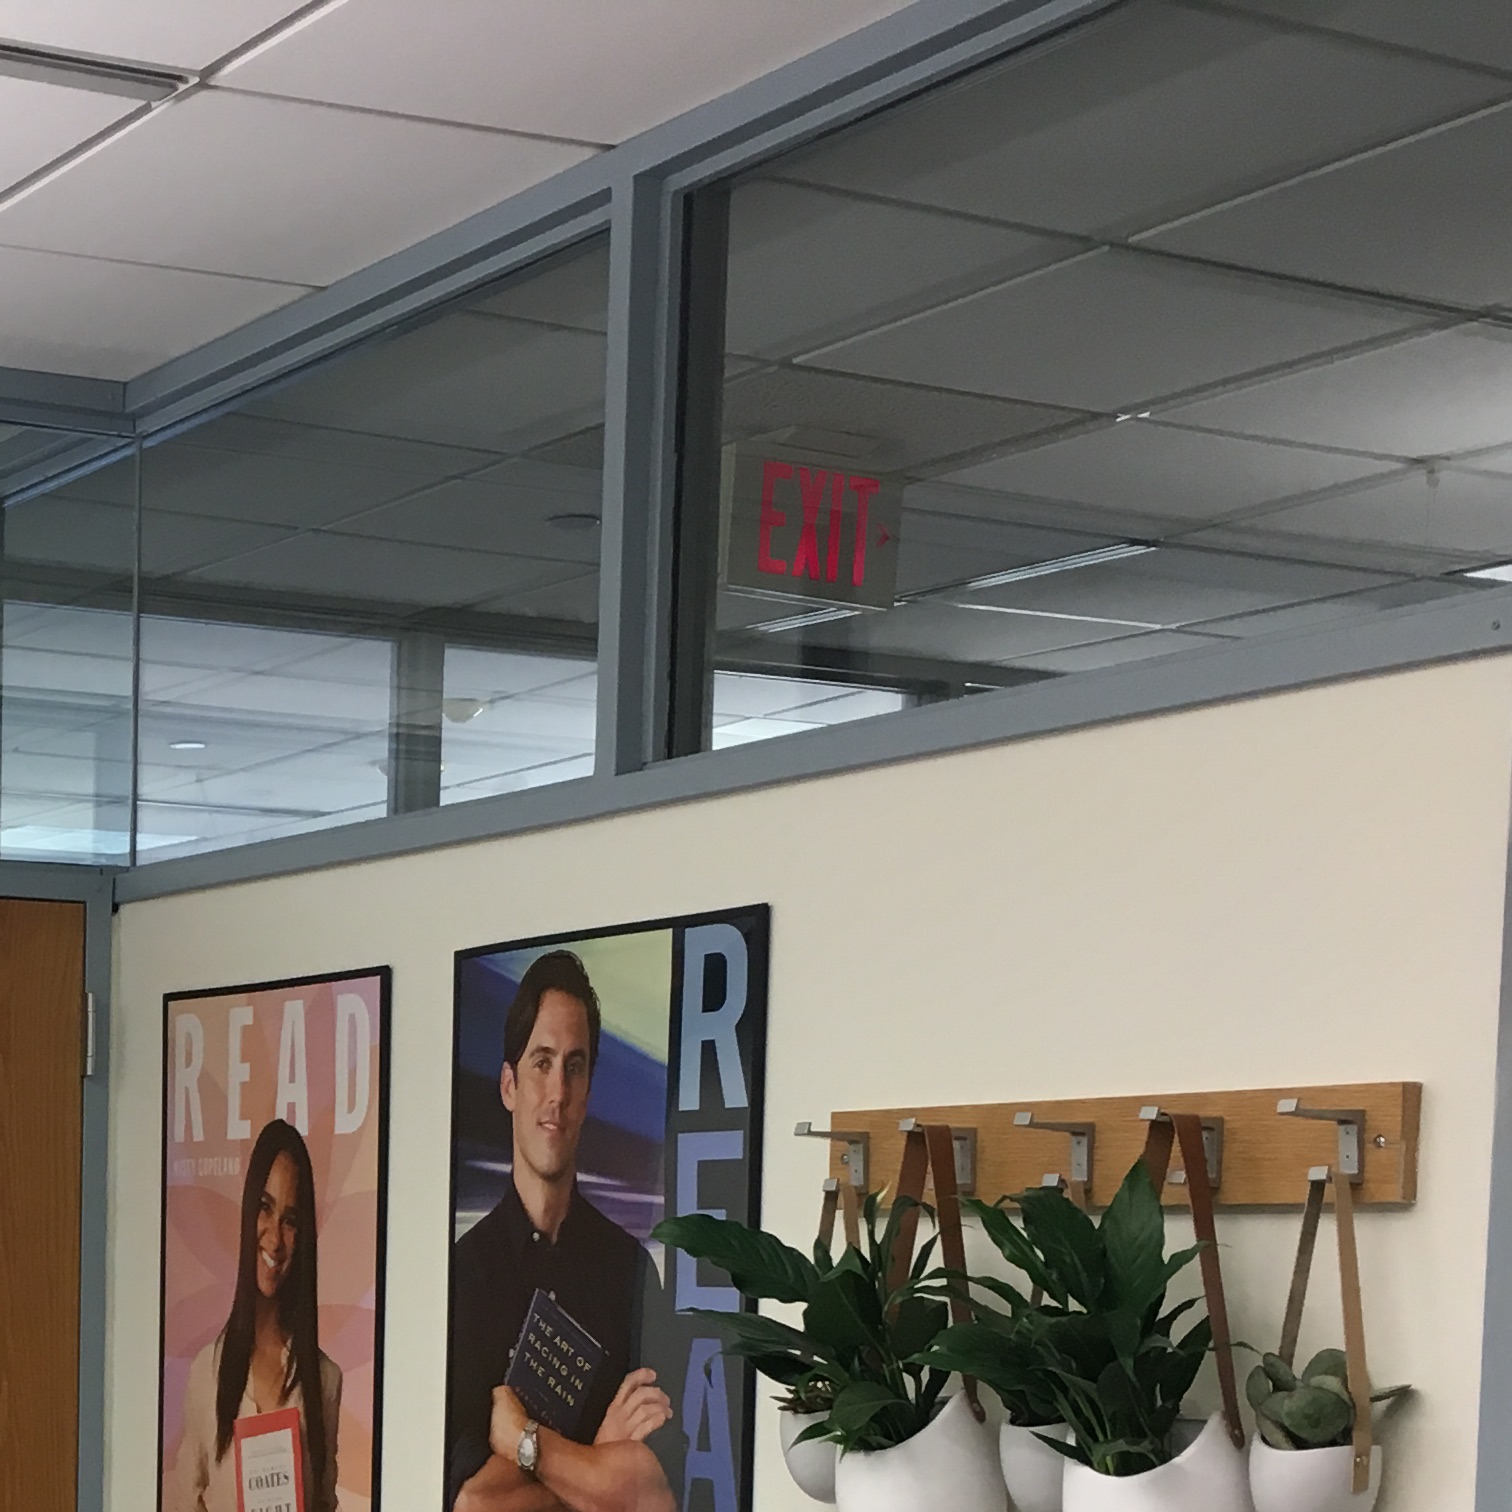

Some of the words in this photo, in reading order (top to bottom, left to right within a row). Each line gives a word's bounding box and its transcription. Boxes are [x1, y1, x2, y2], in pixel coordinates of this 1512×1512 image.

[757, 461, 881, 588] EXIT
[173, 993, 372, 1143] READ
[528, 1332, 569, 1377] RACING
[569, 1374, 584, 1391] IN
[532, 1312, 553, 1337] THE
[553, 1335, 575, 1357] ART
[576, 1356, 592, 1374] OF
[523, 1351, 546, 1378] THE
[546, 1376, 575, 1407] RAIN
[248, 1471, 290, 1492] COATES
